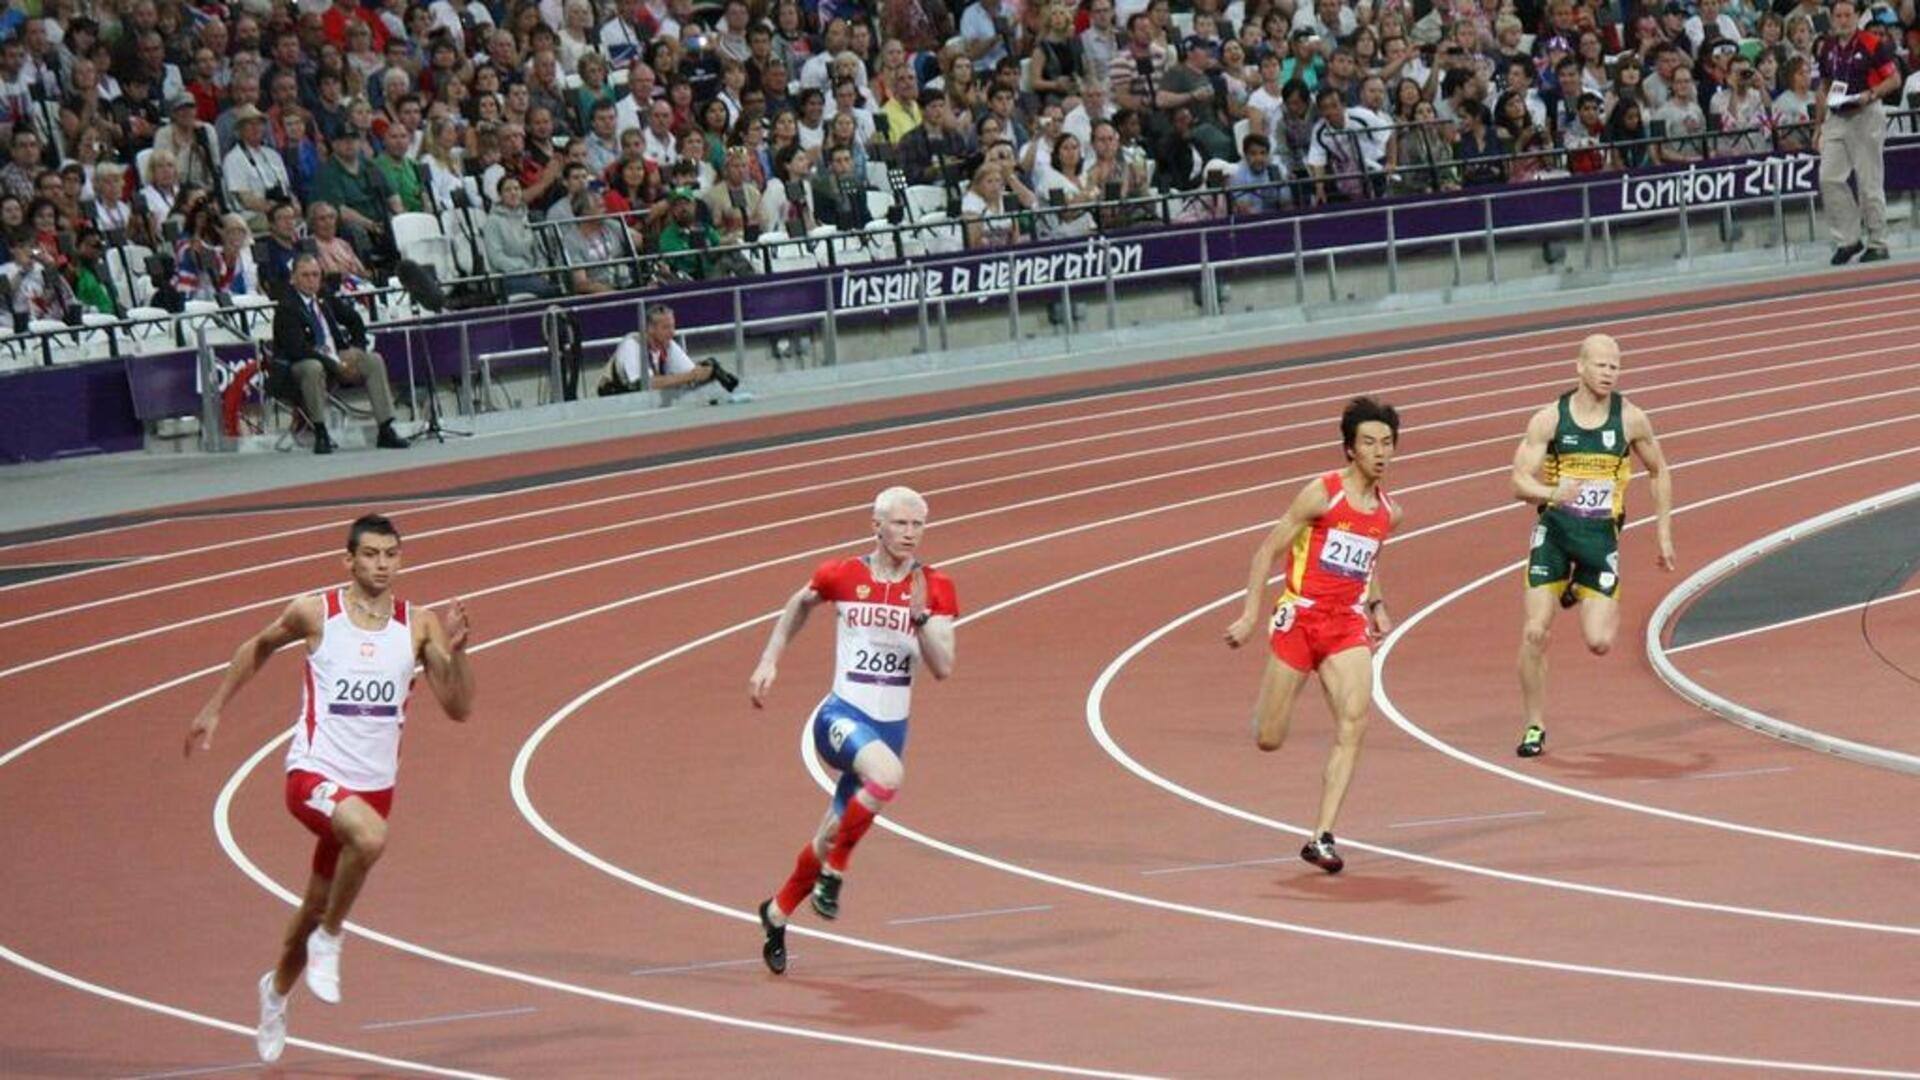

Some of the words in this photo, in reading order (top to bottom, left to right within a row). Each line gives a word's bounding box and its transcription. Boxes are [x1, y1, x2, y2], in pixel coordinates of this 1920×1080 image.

[1621, 164, 1735, 211] London
[1745, 152, 1814, 195] 2012
[841, 260, 943, 314] Inspire
[951, 267, 971, 294] a
[977, 236, 1143, 302] generation
[1574, 489, 1609, 507] 637
[1274, 606, 1288, 628] 3
[855, 649, 912, 674] 2684
[335, 679, 396, 702] 2600
